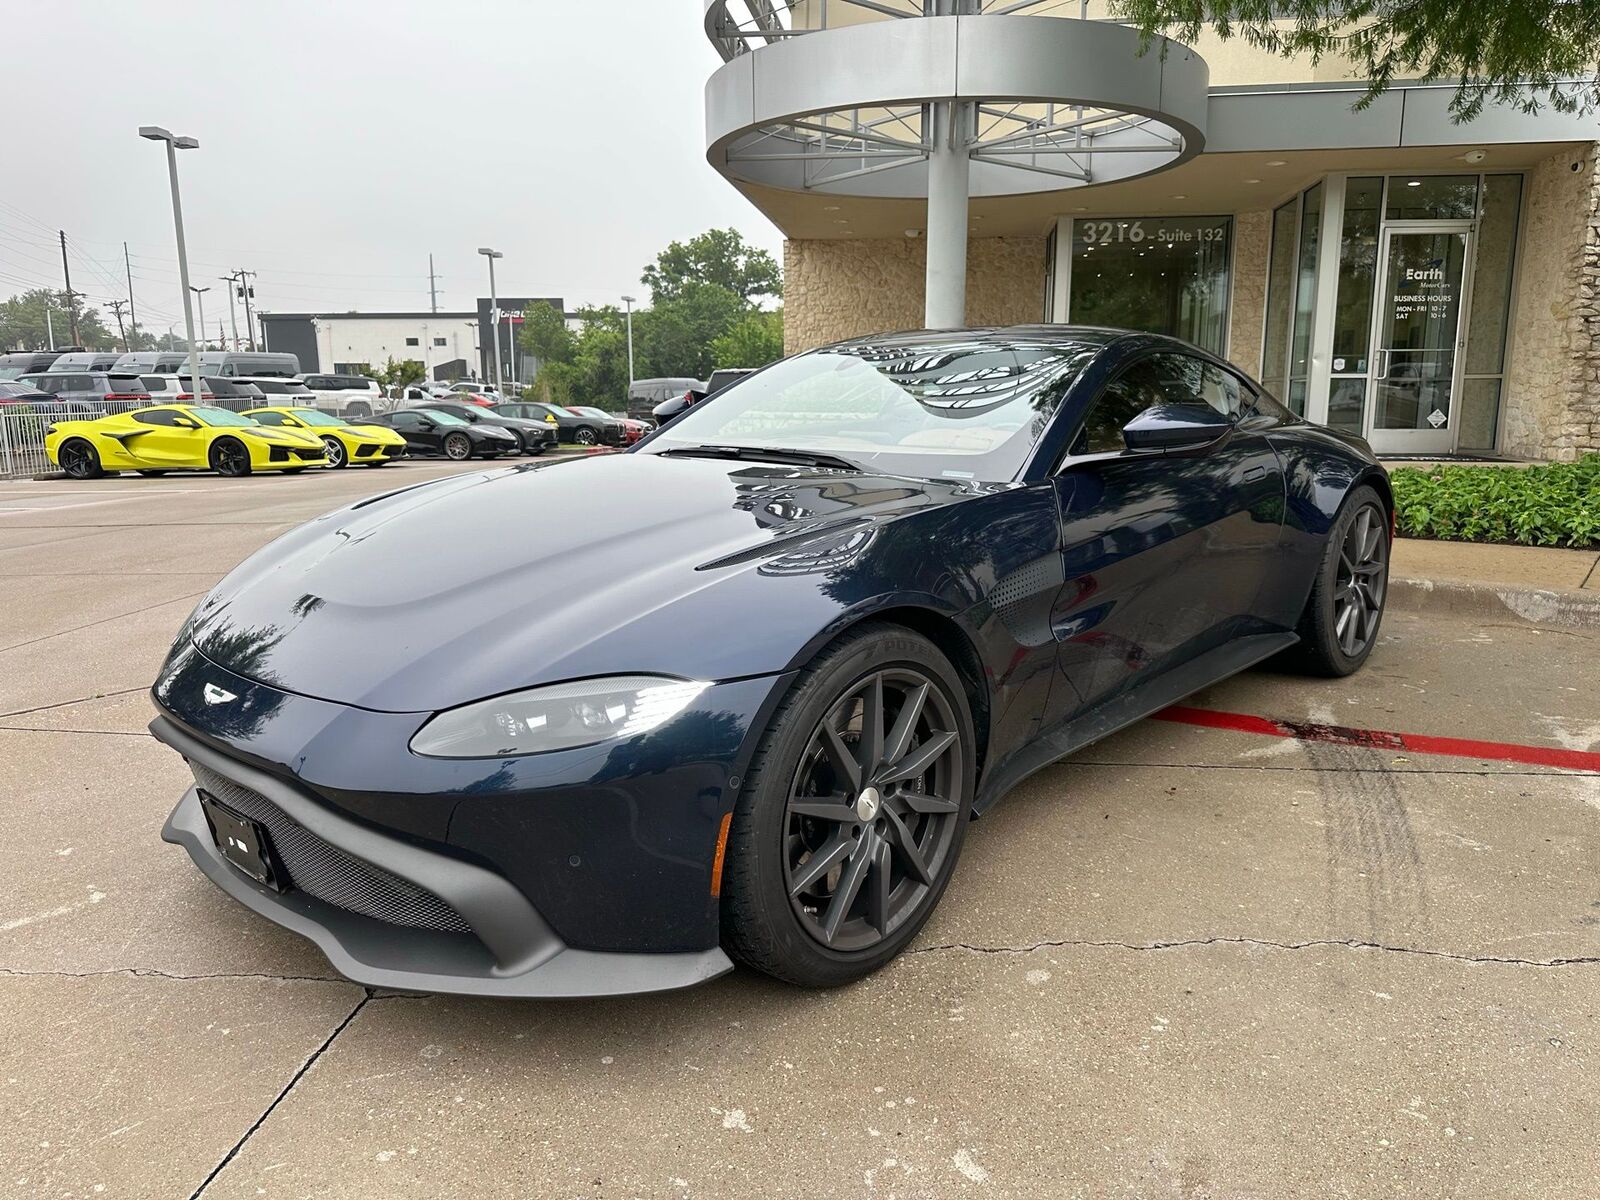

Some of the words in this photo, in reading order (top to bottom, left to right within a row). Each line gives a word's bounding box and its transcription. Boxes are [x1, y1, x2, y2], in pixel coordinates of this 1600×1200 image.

[1083, 221, 1145, 243] 3216
[1157, 229, 1193, 242] Suite
[1196, 228, 1223, 241] 132
[1406, 268, 1443, 280] Earth
